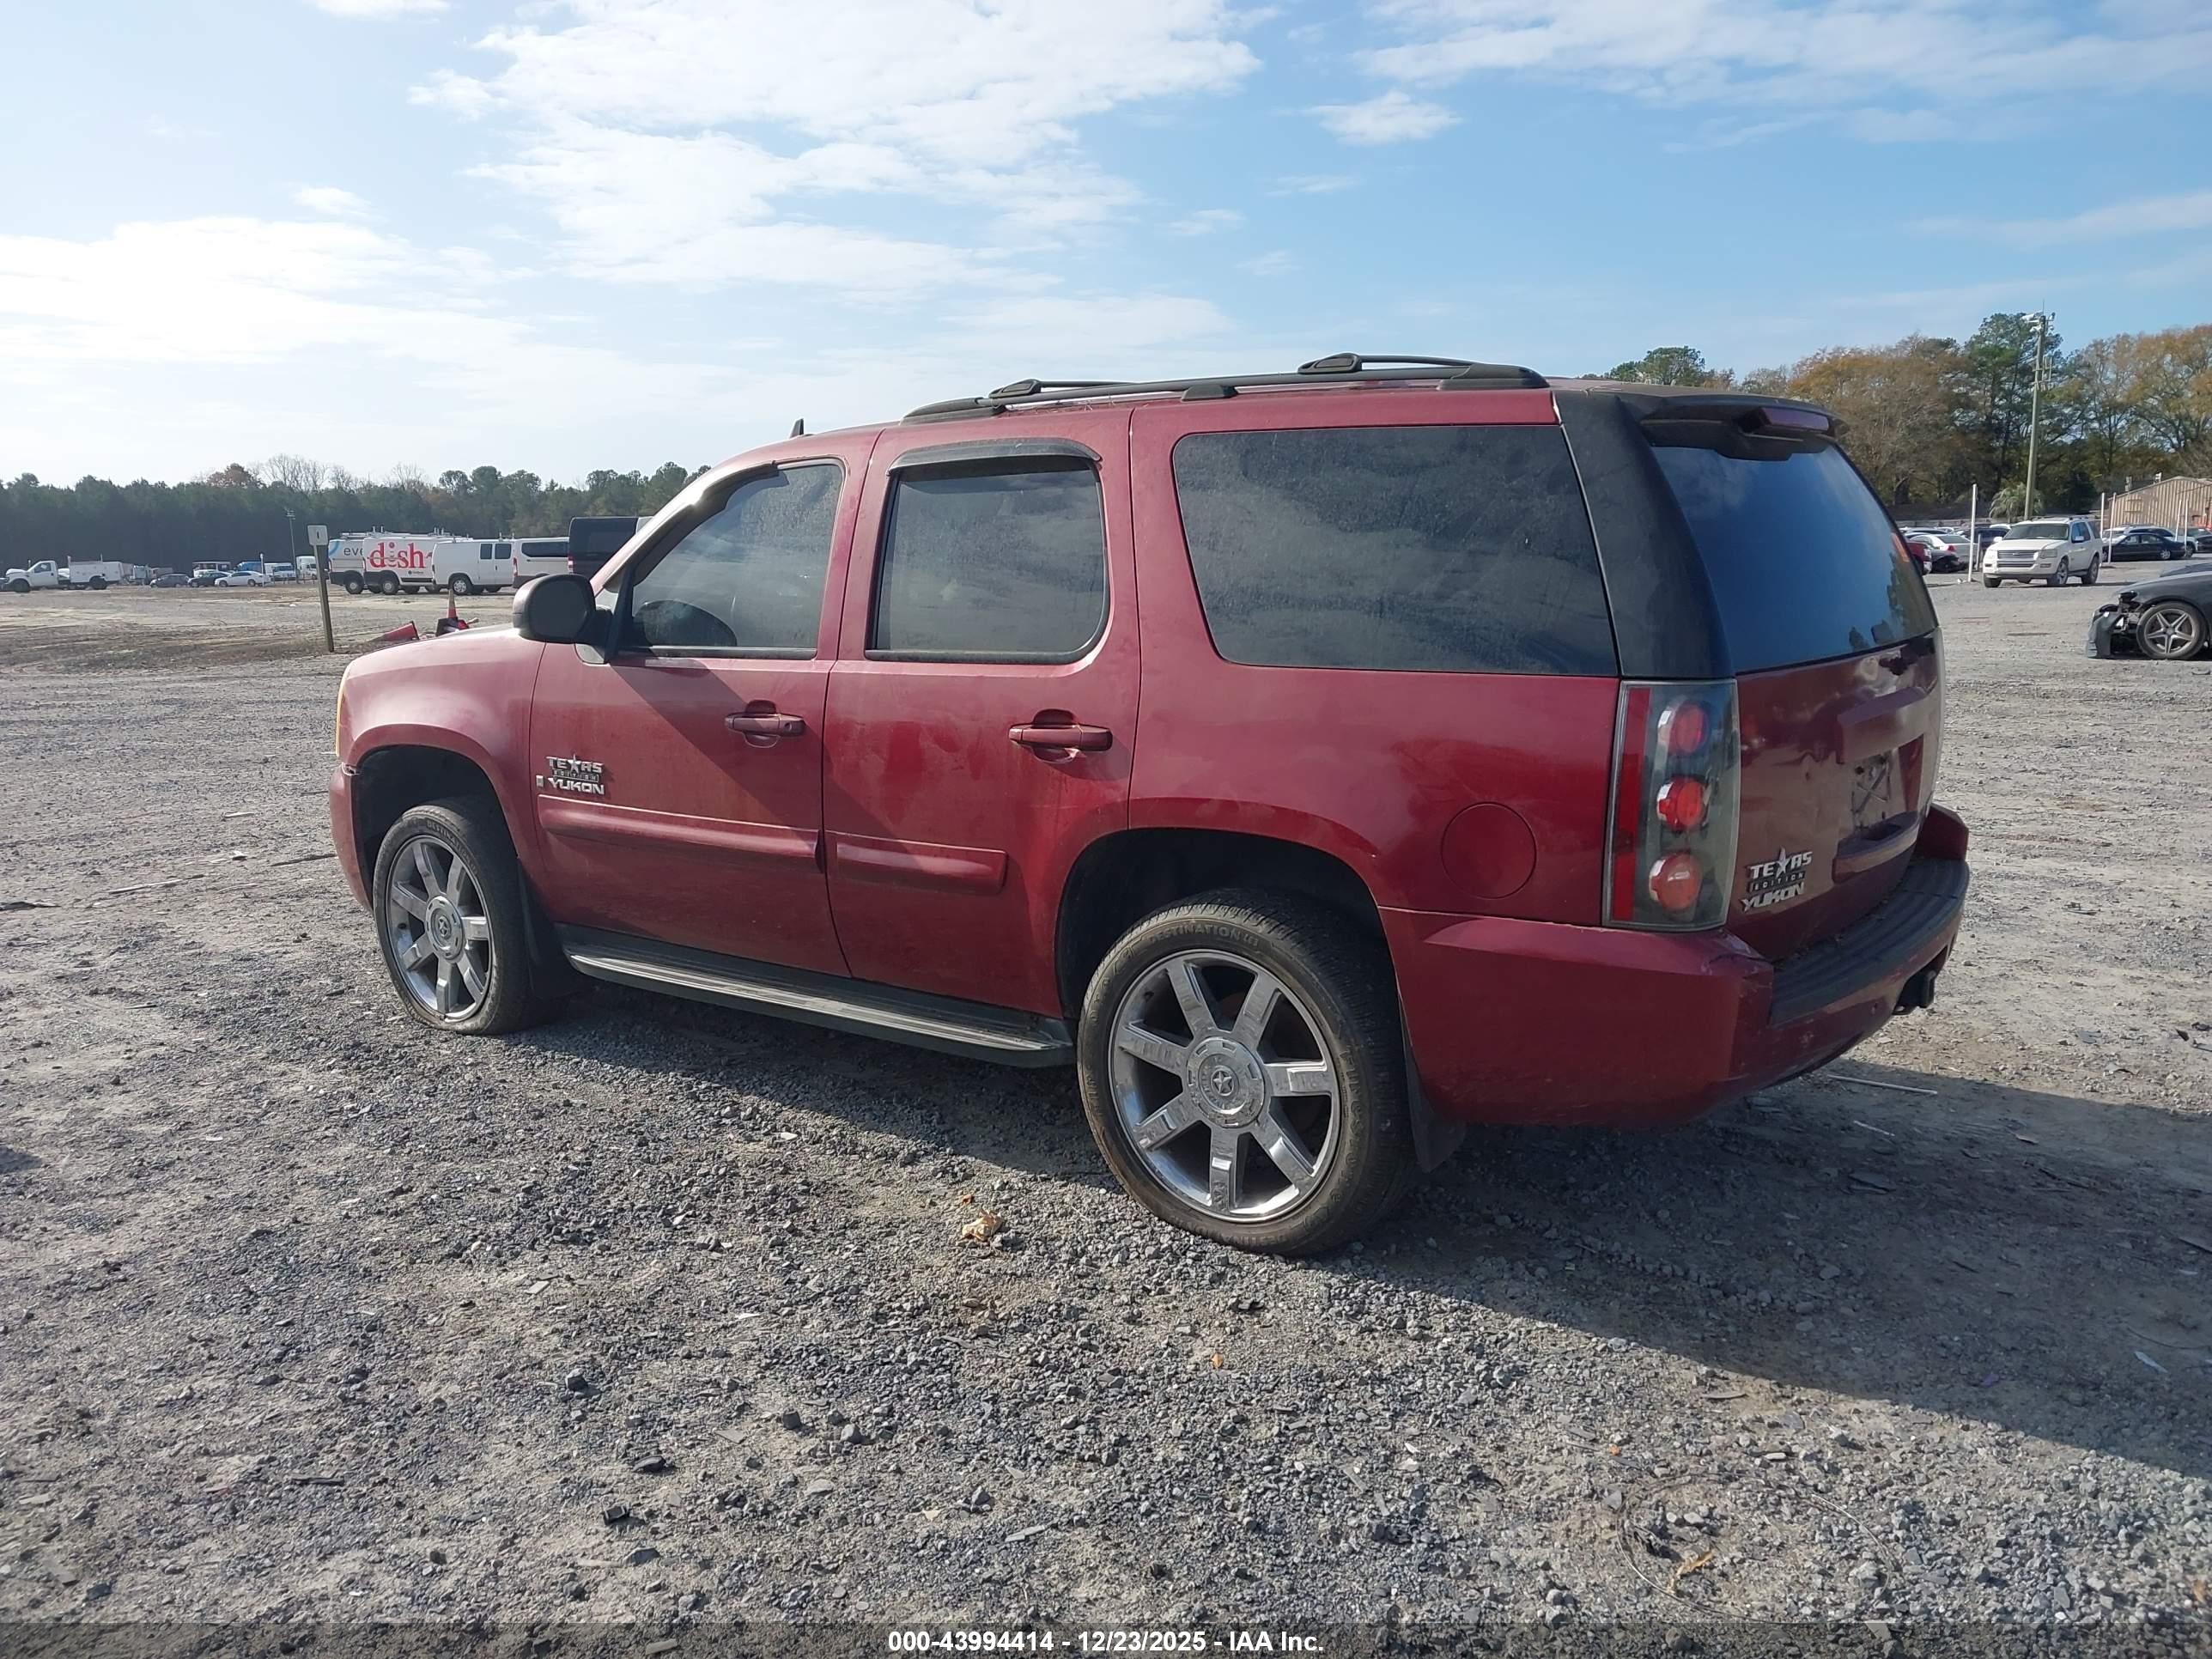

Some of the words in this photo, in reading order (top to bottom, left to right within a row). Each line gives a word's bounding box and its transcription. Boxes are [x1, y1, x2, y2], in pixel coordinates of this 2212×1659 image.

[370, 541, 426, 568] dish
[546, 753, 605, 774] TEXAS
[547, 777, 605, 795] YUKON
[1750, 847, 1813, 880] TEXAS
[1741, 882, 1804, 911] YUKON
